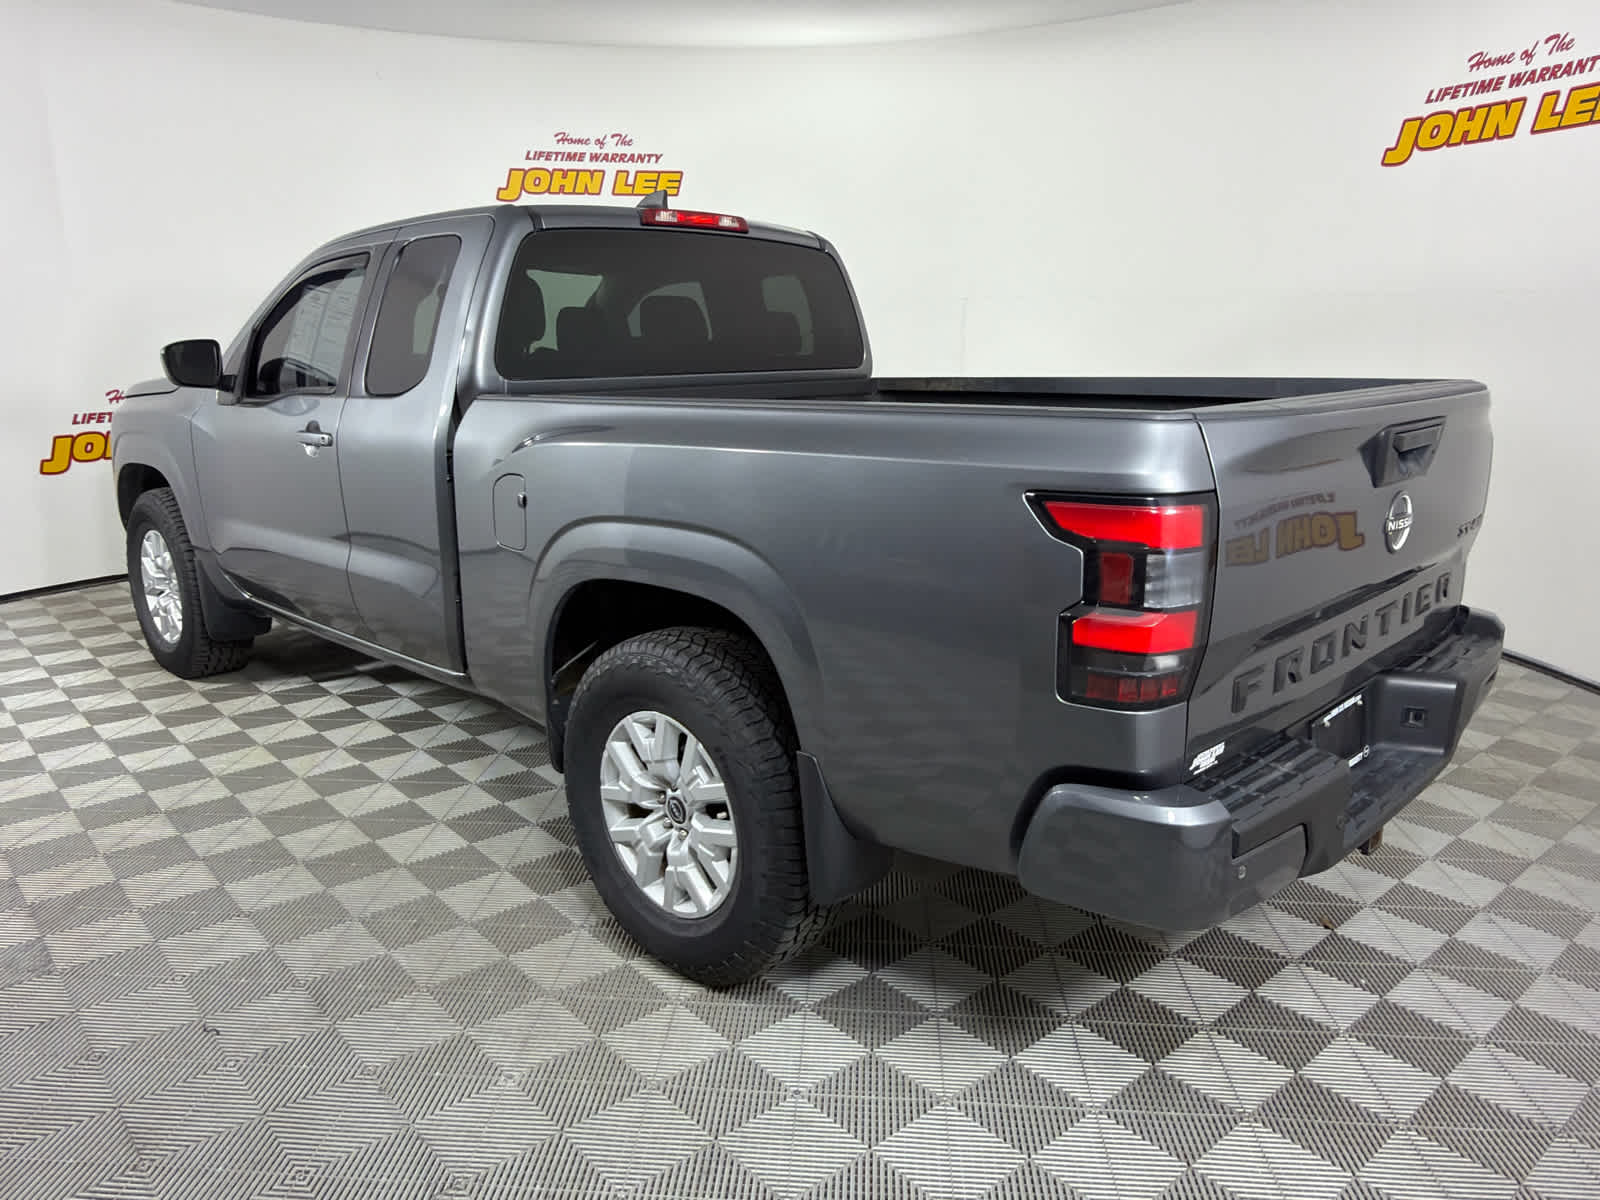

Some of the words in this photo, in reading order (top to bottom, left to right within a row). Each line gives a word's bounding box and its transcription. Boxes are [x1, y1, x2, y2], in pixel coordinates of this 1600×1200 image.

[1467, 51, 1515, 73] Home
[1520, 40, 1540, 66] of
[1544, 32, 1575, 56] The
[1424, 75, 1507, 104] LIFETIME
[1508, 54, 1600, 89] WARRANT
[553, 132, 591, 146] Home
[594, 134, 607, 149] of
[610, 133, 634, 147] The
[1381, 96, 1528, 167] JOHN
[1530, 81, 1600, 135] LE
[525, 150, 586, 162] LIFETIME
[588, 152, 663, 164] WARRANTY
[496, 167, 605, 202] JOHN
[612, 170, 683, 196] LEE
[71, 411, 113, 425] LIFET
[40, 430, 112, 475] JO
[1387, 516, 1412, 531] NISS
[1230, 572, 1451, 714] FRONTIER
